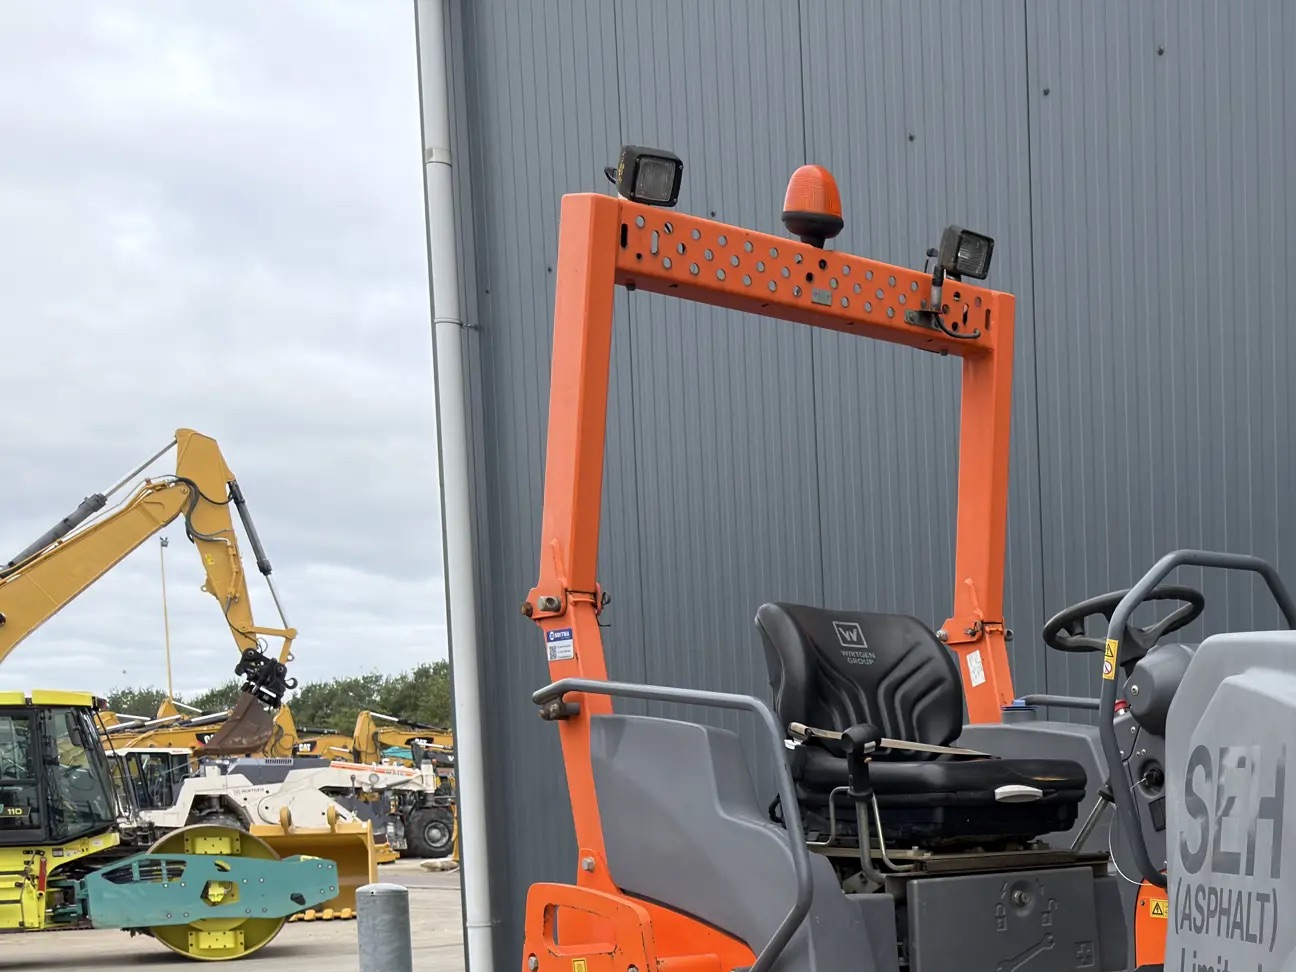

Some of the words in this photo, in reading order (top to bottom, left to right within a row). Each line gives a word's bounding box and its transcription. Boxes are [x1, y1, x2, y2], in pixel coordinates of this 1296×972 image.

[847, 657, 874, 665] GROUP
[298, 744, 310, 752] CAT
[1174, 877, 1278, 952] (ASPHALT)
